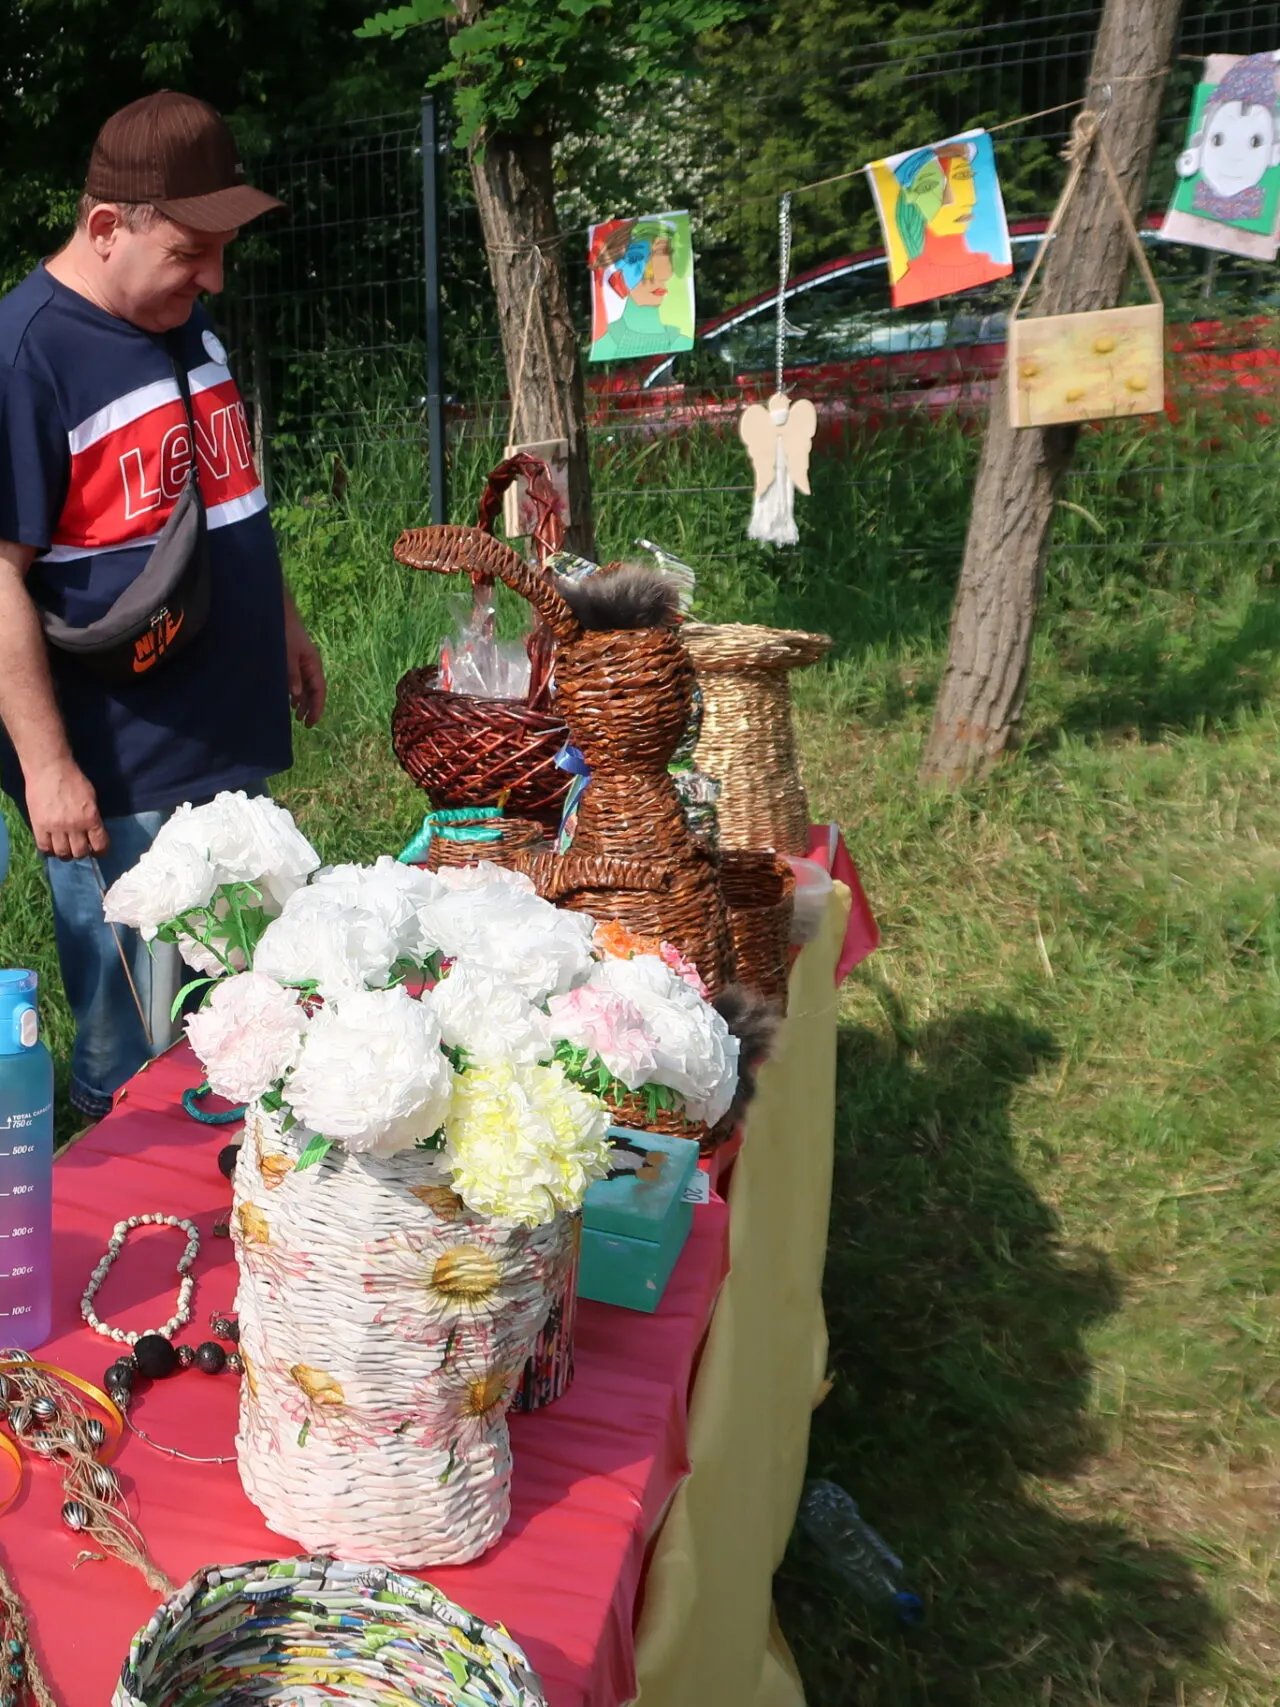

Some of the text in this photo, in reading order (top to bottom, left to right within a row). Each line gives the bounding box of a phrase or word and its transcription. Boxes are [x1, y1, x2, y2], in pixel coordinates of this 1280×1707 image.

[12, 1113, 31, 1121] TOTAL
[12, 1119, 26, 1129] 750
[12, 1184, 27, 1195] 400
[11, 1226, 27, 1237] 300
[11, 1266, 27, 1277] 200
[11, 1305, 25, 1316] 100
